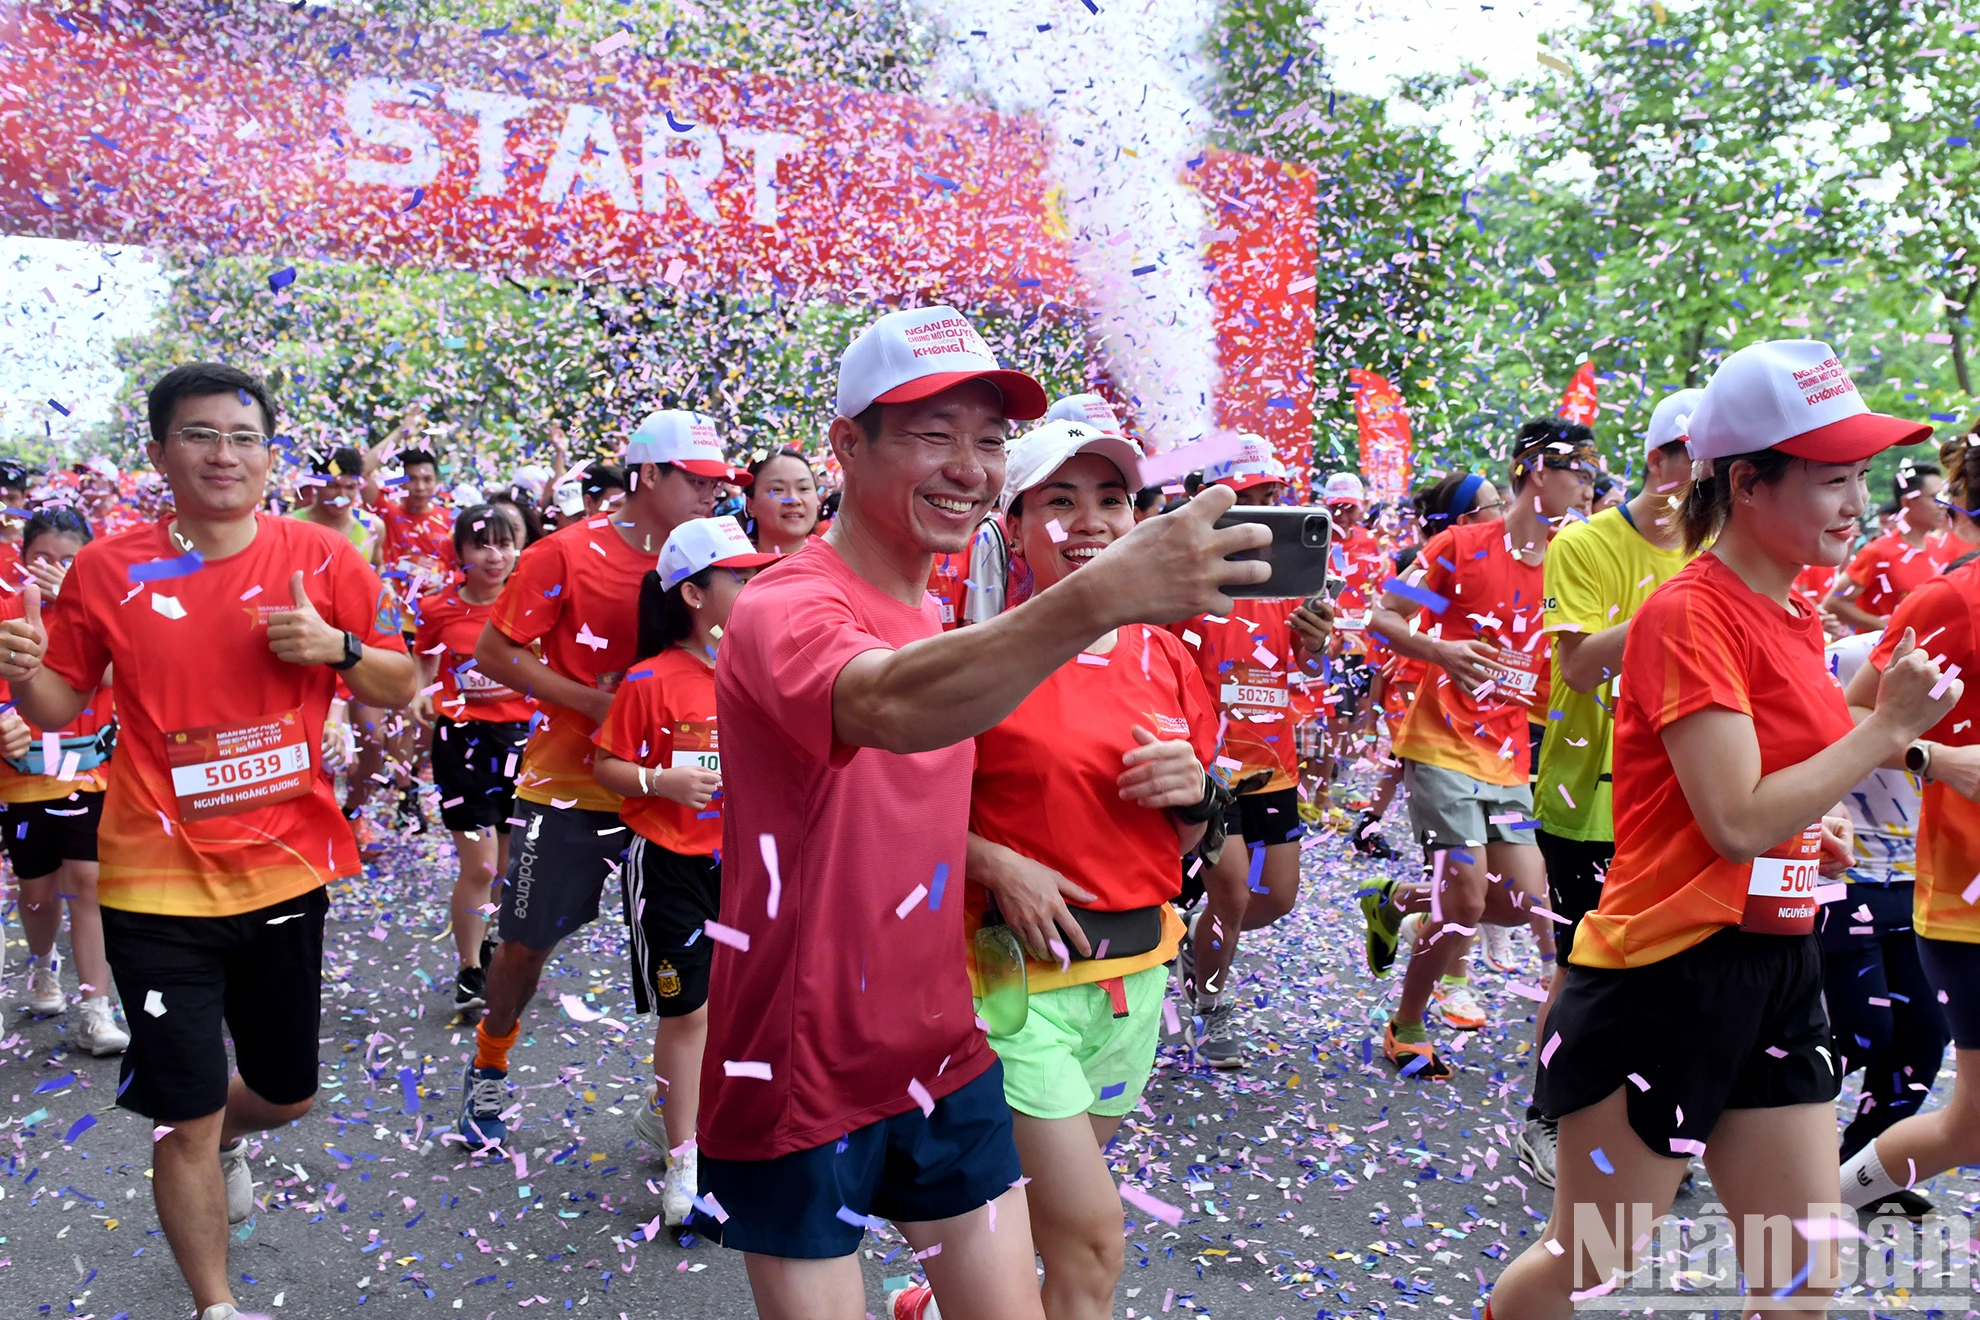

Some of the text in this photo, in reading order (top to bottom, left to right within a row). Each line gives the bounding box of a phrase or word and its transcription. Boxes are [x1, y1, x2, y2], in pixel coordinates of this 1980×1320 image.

[343, 77, 797, 226] START
[1237, 687, 1276, 704] 50276
[204, 754, 282, 787] 50639
[235, 786, 268, 802] HOÀNG
[514, 851, 539, 919] balance
